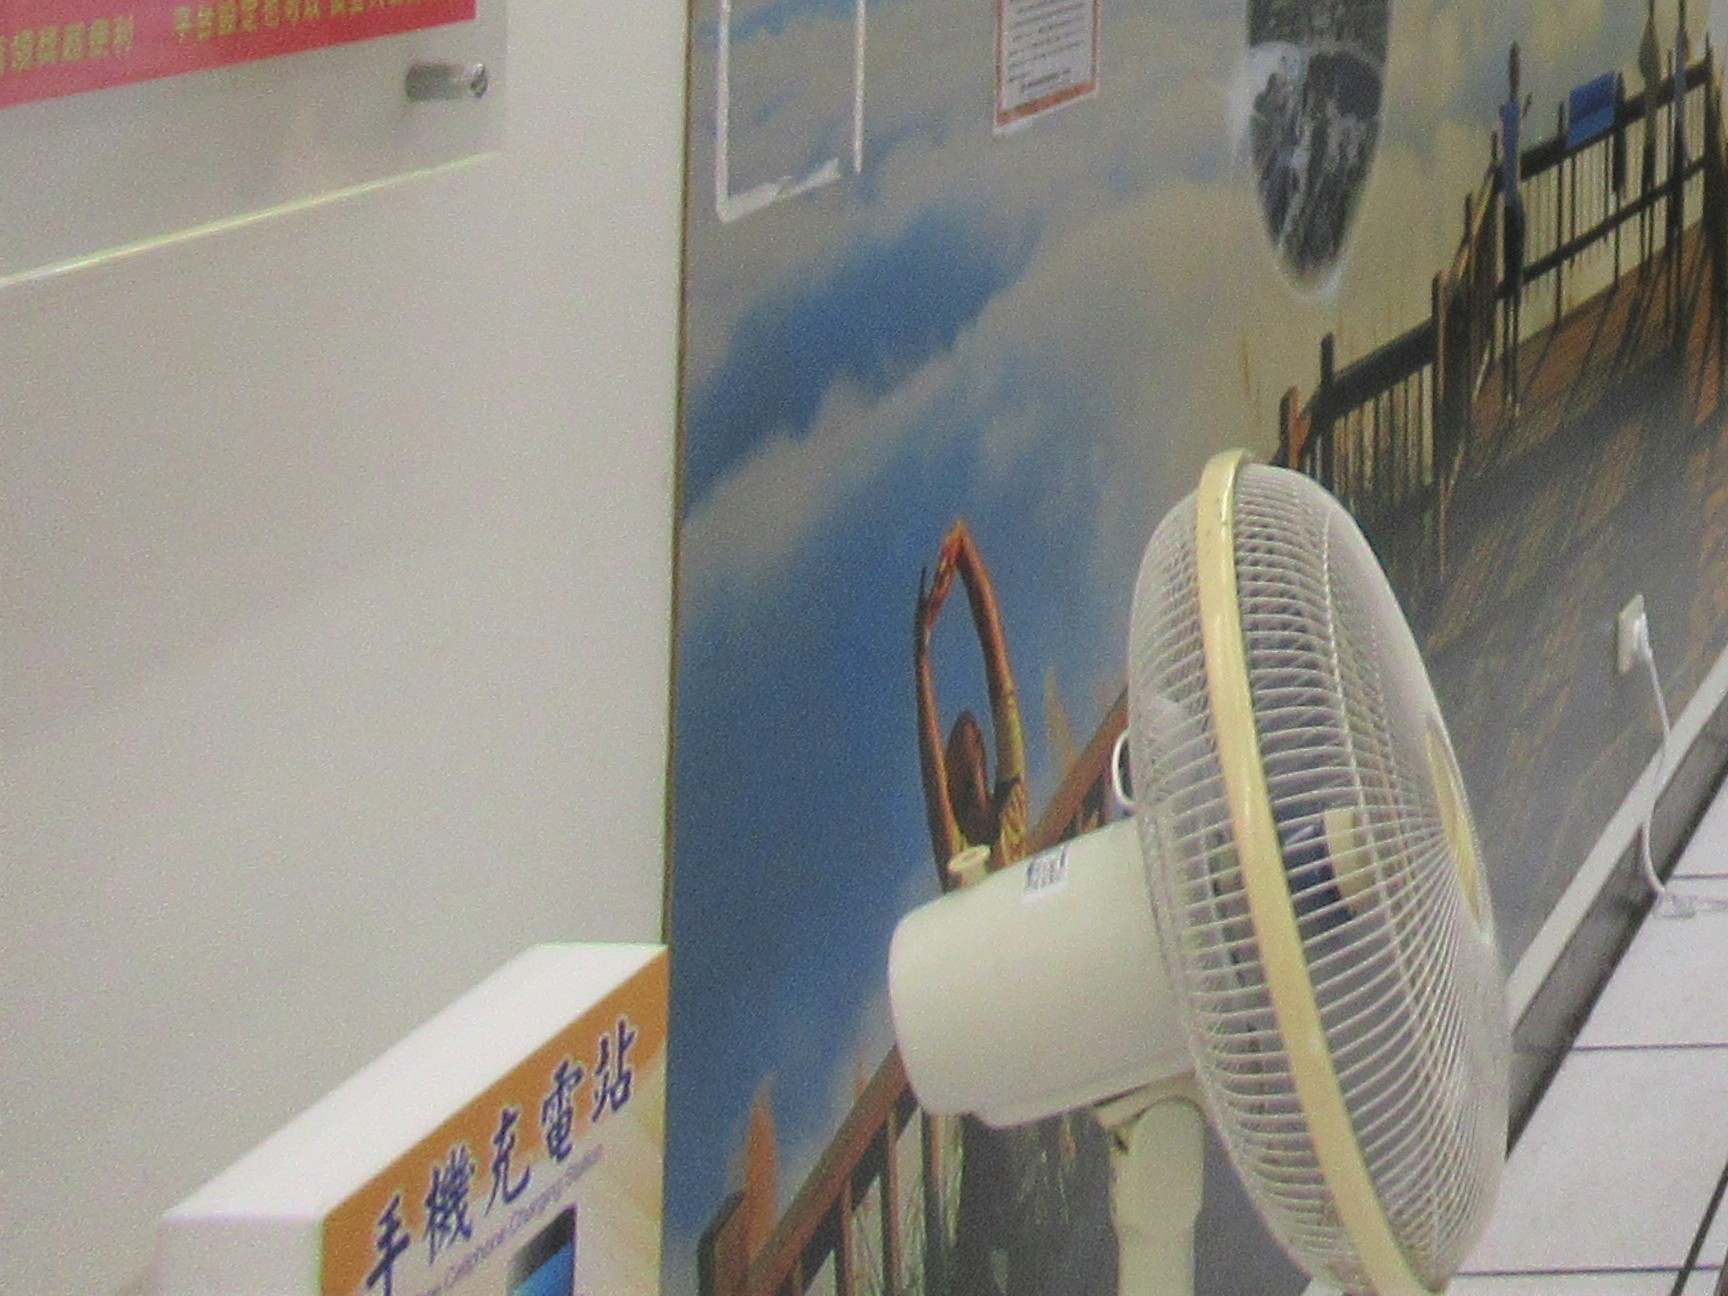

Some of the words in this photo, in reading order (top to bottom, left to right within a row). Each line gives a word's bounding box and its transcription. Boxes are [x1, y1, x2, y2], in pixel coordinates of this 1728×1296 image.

[365, 1014, 636, 1296] 手機充電站
